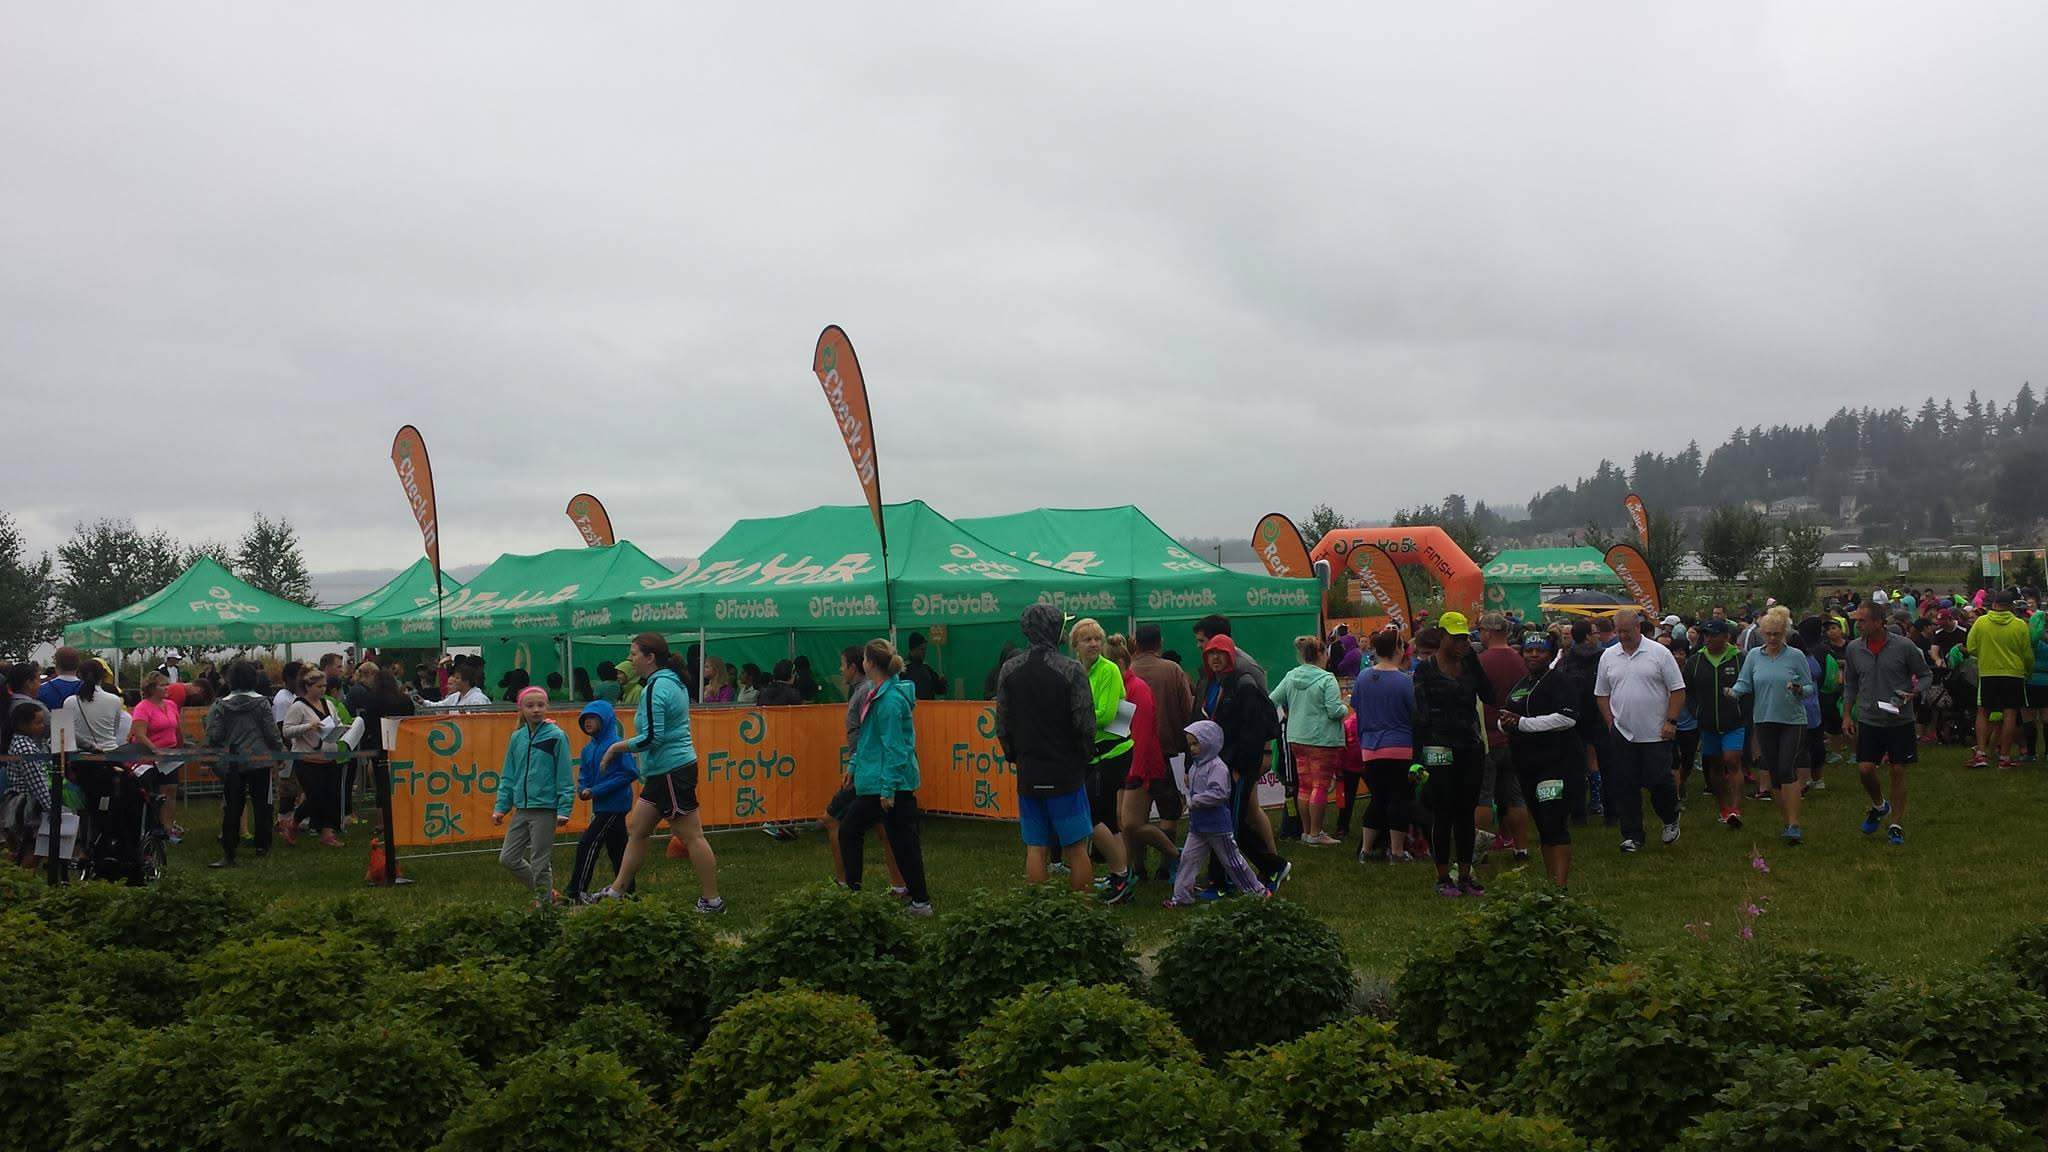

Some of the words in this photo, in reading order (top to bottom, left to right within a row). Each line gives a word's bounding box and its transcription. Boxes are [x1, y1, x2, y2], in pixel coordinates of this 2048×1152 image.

[1423, 546, 1456, 579] FINISH
[390, 761, 499, 796] FroYo
[707, 750, 796, 783] FroYo
[735, 787, 766, 818] 5k
[973, 780, 999, 811] 5k
[424, 802, 464, 838] 5k
